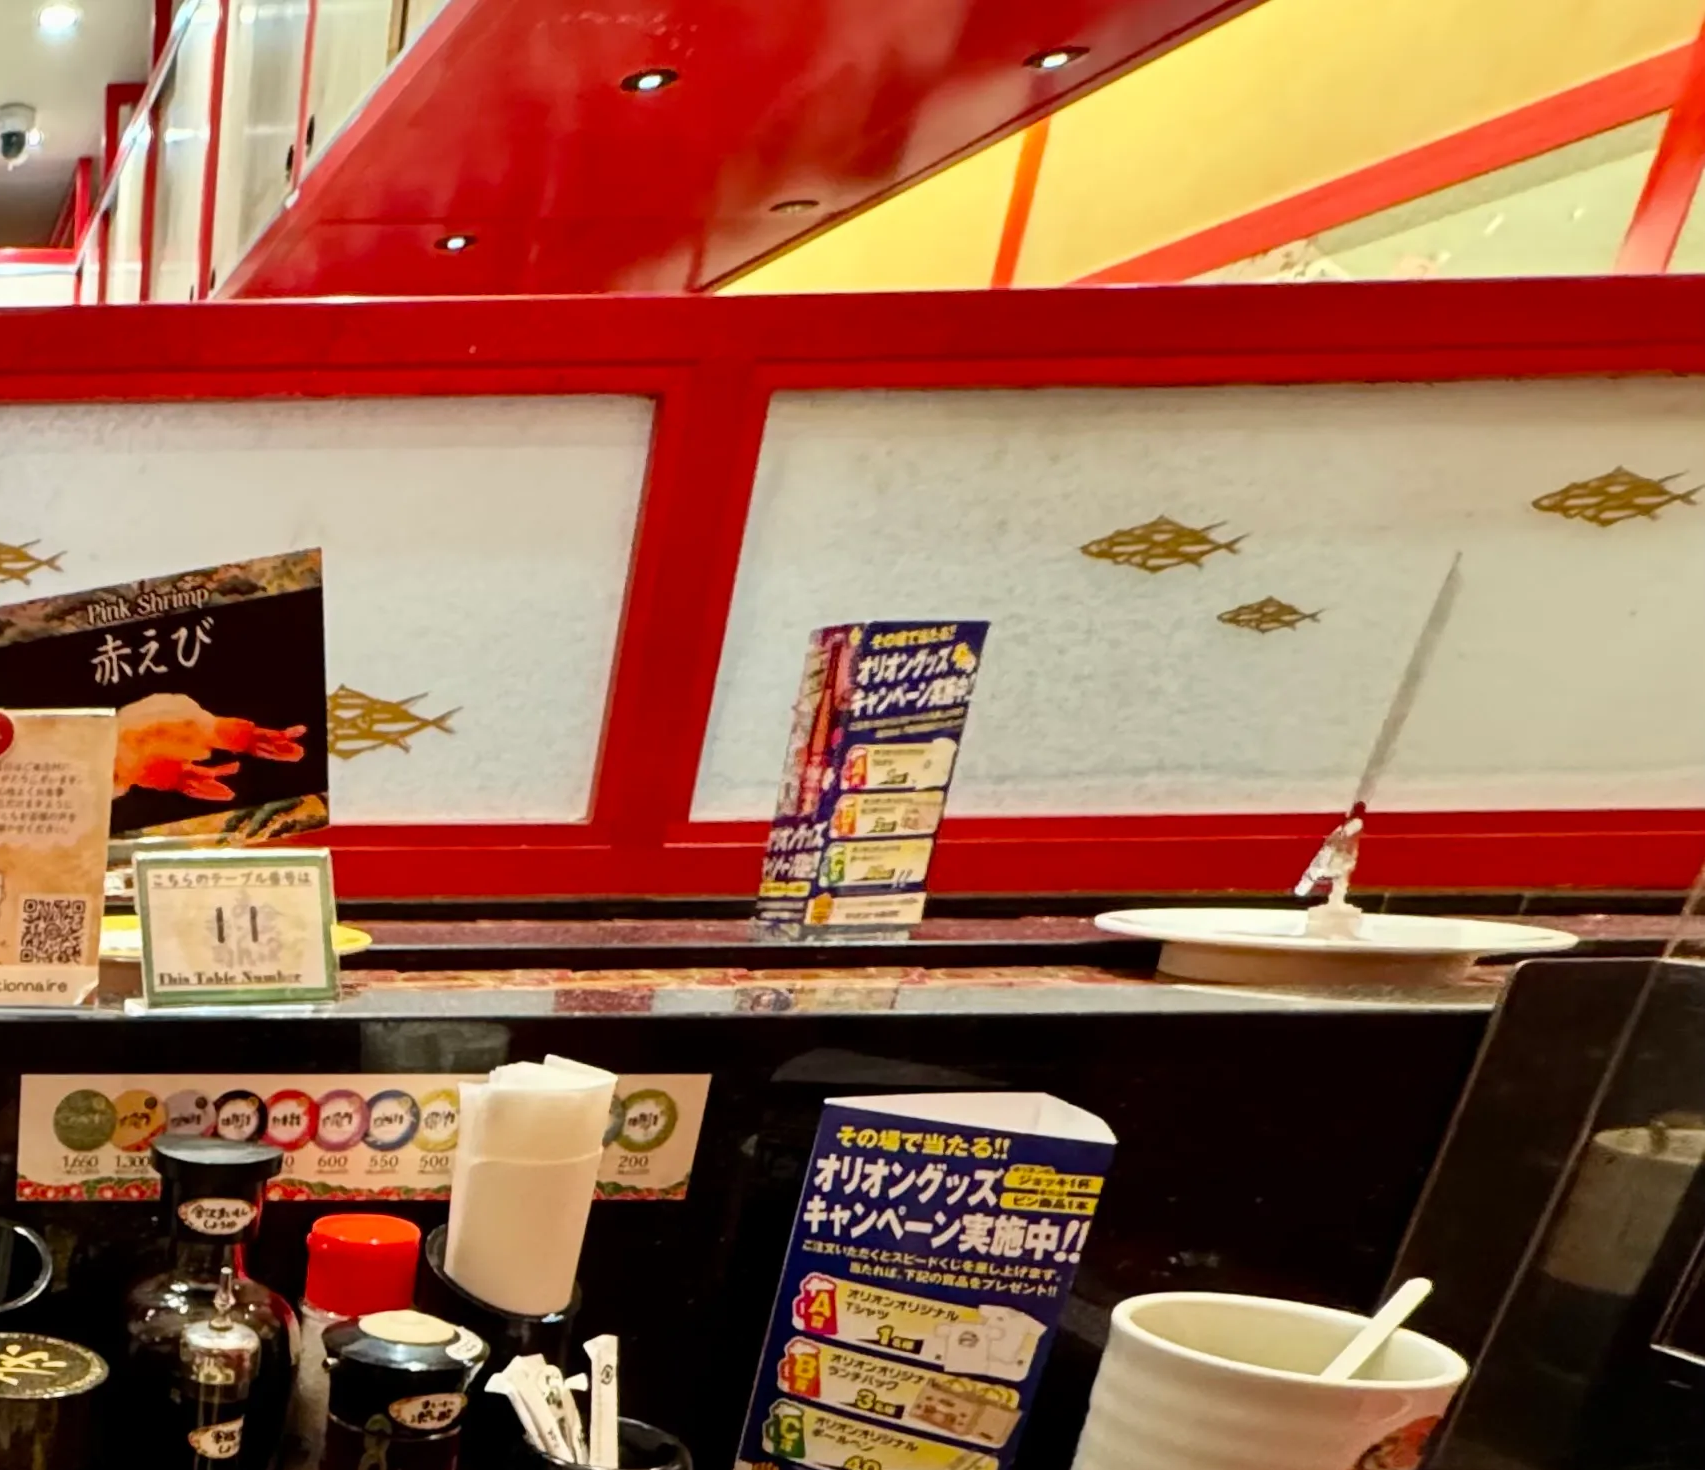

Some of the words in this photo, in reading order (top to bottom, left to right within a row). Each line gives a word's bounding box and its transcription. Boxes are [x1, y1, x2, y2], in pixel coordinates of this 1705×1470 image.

[87, 597, 131, 625] Pink
[137, 588, 209, 614] Shrimp
[91, 616, 214, 686] 赤えび
[152, 871, 311, 887] こちらのテーブル番号は
[216, 906, 258, 943] 11
[159, 972, 190, 985] This
[194, 972, 236, 985] Table
[241, 970, 303, 984] Number
[837, 1125, 1011, 1159] その場で当たる!!
[317, 1156, 348, 1168] 600
[369, 1156, 399, 1168] 550
[419, 1156, 449, 1169] 500
[618, 1155, 649, 1168] 200
[814, 1154, 1004, 1207] オリオングッズ
[803, 1195, 1090, 1264] キャンペーン実施中!!
[847, 1288, 959, 1321] オリオンオリジナル
